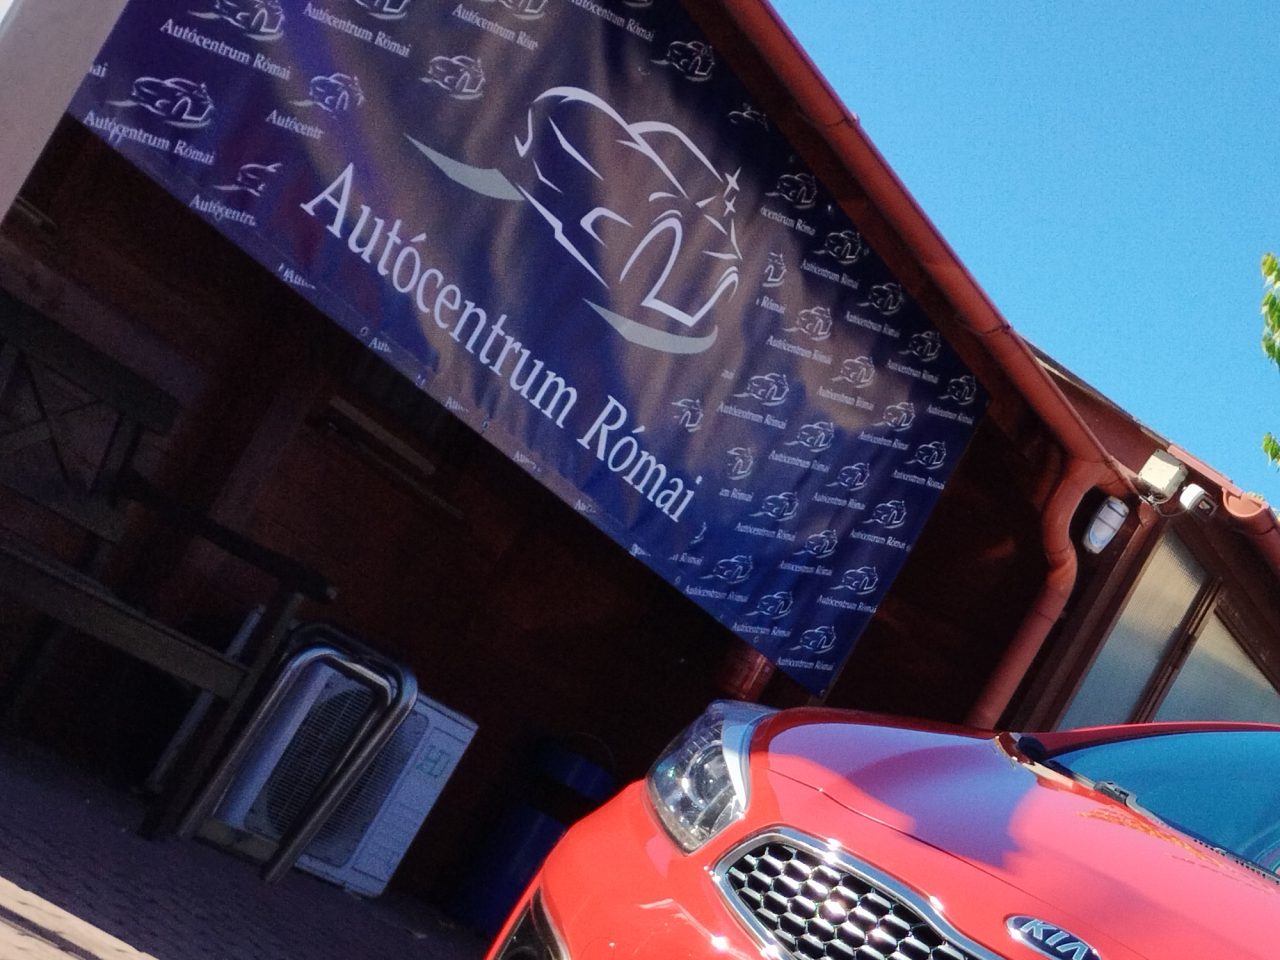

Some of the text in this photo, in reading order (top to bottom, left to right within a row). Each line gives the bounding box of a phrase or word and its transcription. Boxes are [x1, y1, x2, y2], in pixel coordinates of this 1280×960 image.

[301, 2, 412, 58] Autócentrum Római
[452, 3, 516, 44] Autócentrum
[569, 0, 626, 27] utócentrum
[160, 18, 291, 81] Autócentrum Római
[83, 110, 216, 165] Autócentrum Római
[300, 162, 704, 523] Autócentrum Római
